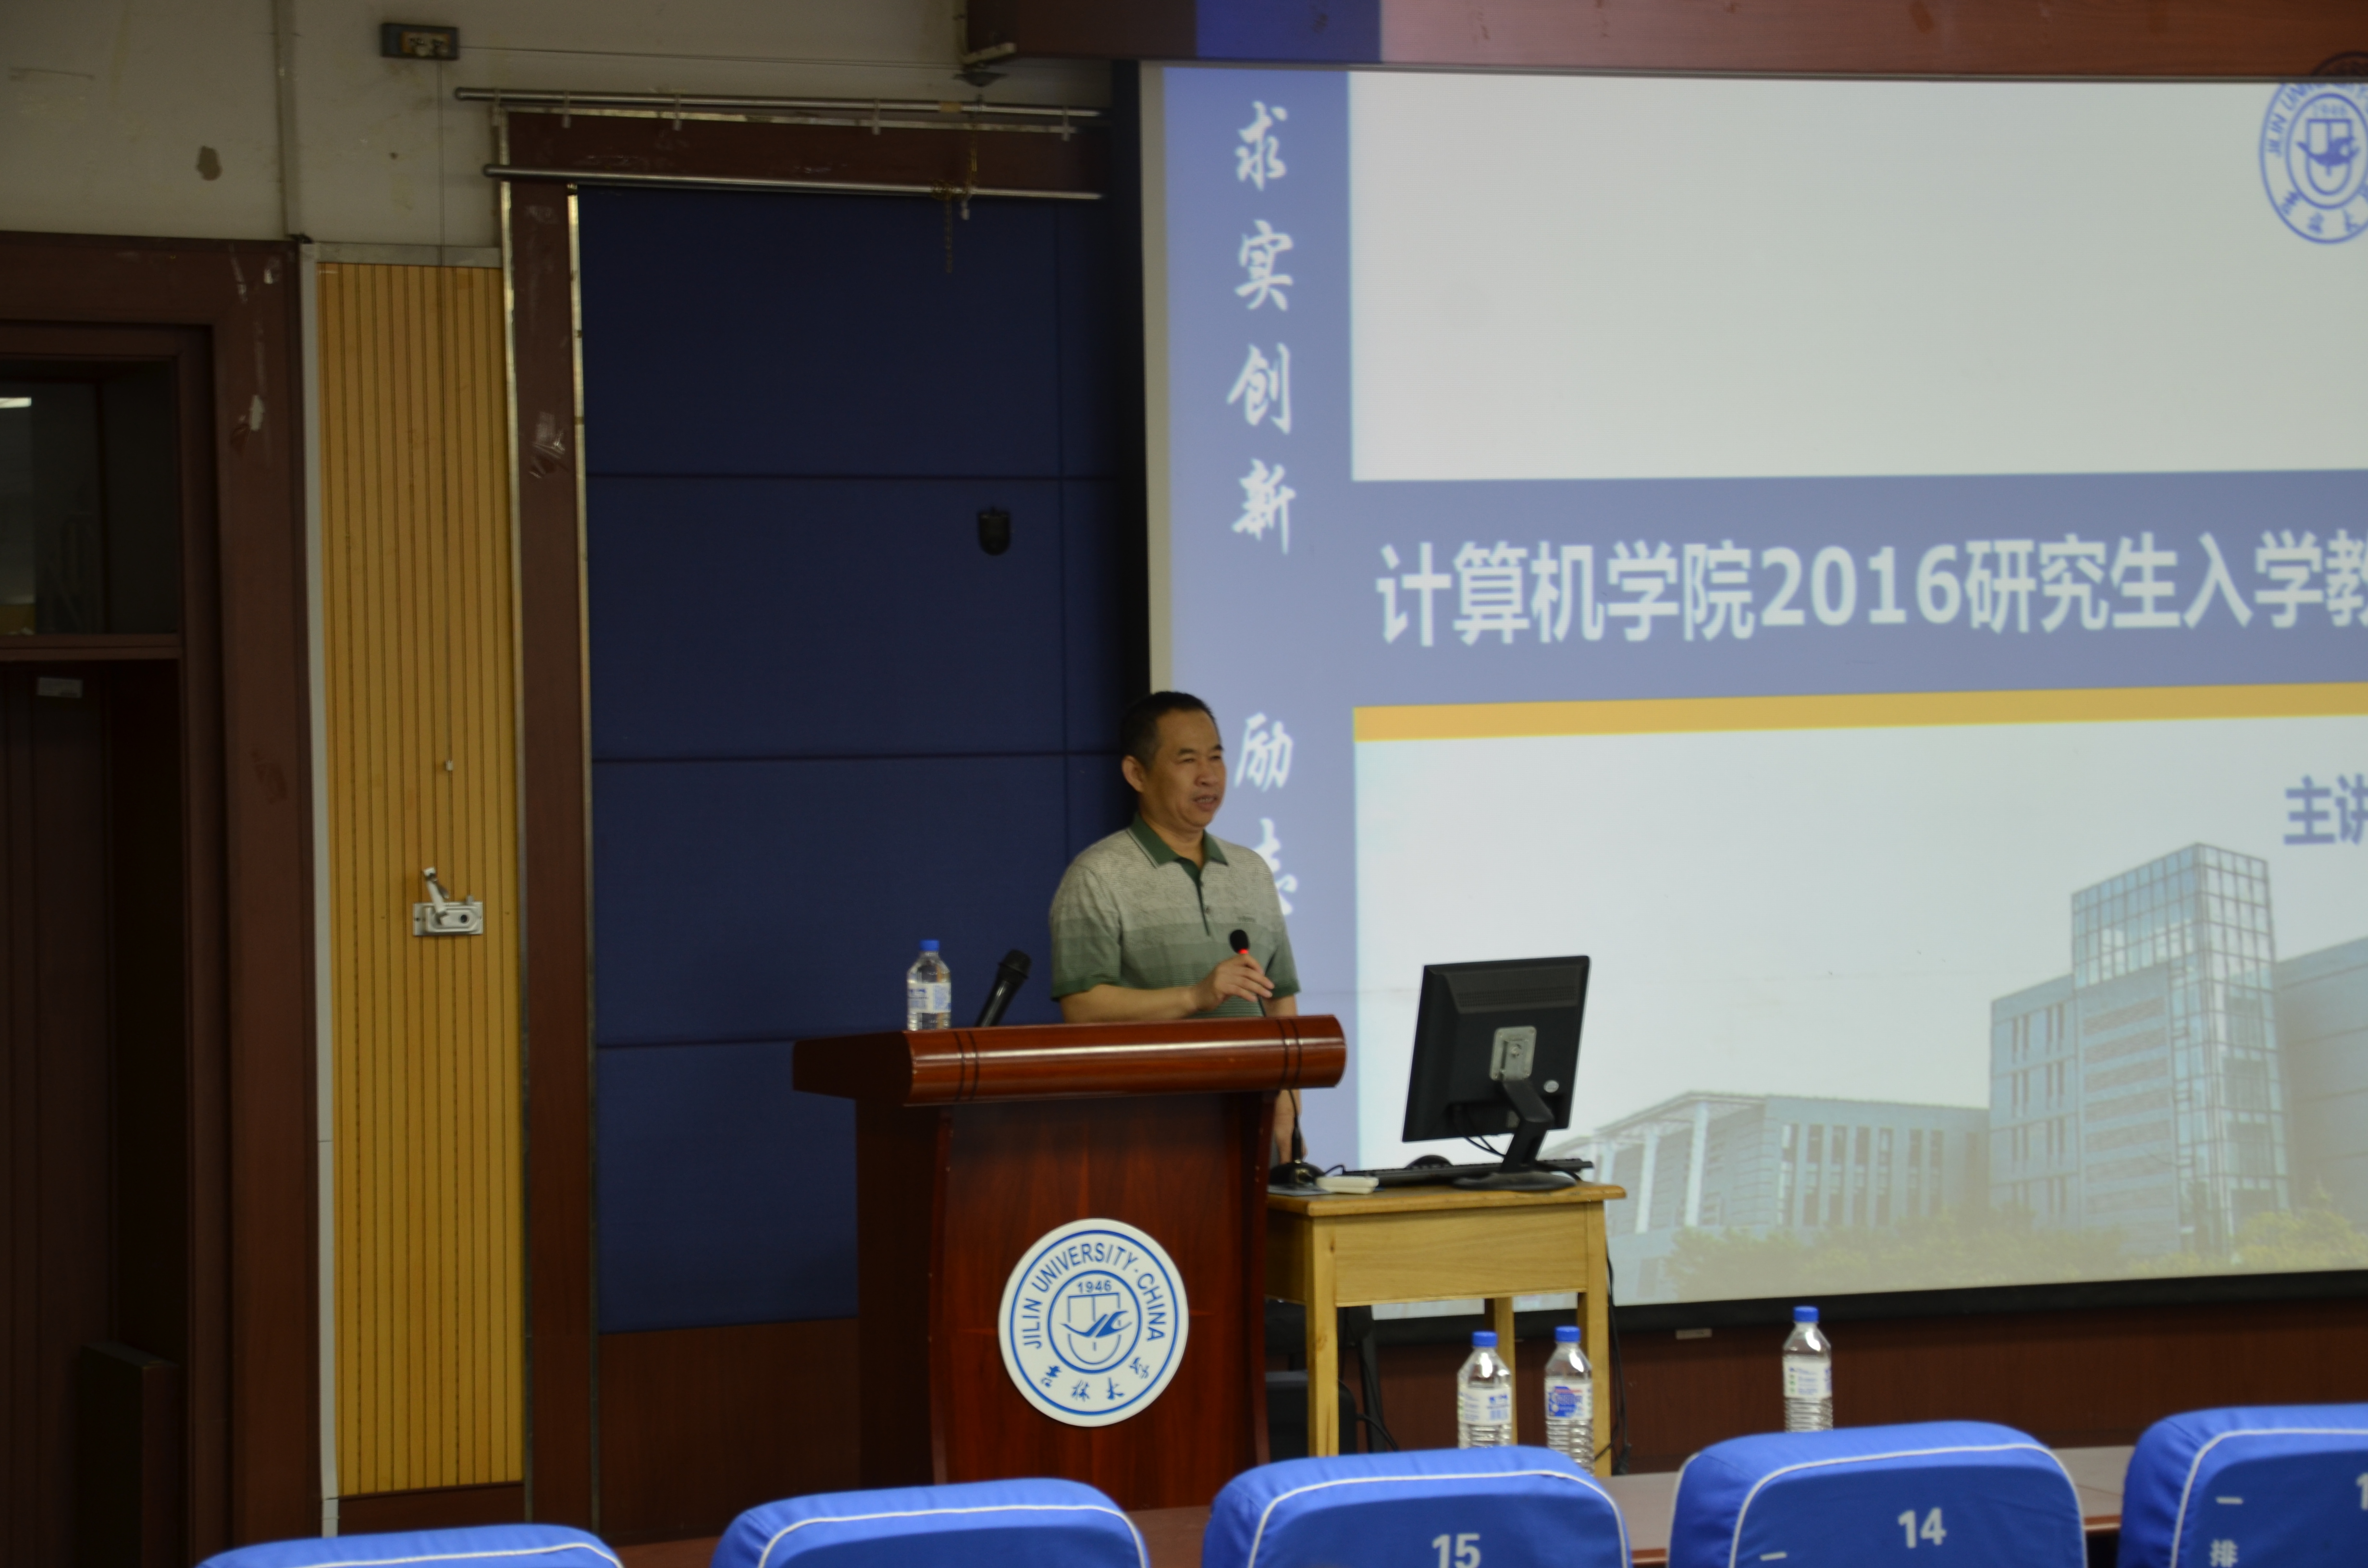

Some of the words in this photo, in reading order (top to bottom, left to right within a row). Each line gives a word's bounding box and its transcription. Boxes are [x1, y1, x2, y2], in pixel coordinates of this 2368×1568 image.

[1077, 1280, 1112, 1294] 1946
[1022, 1298, 1043, 1350] JILIN
[1898, 1507, 1947, 1549] 14
[1431, 1532, 1481, 1568] 15
